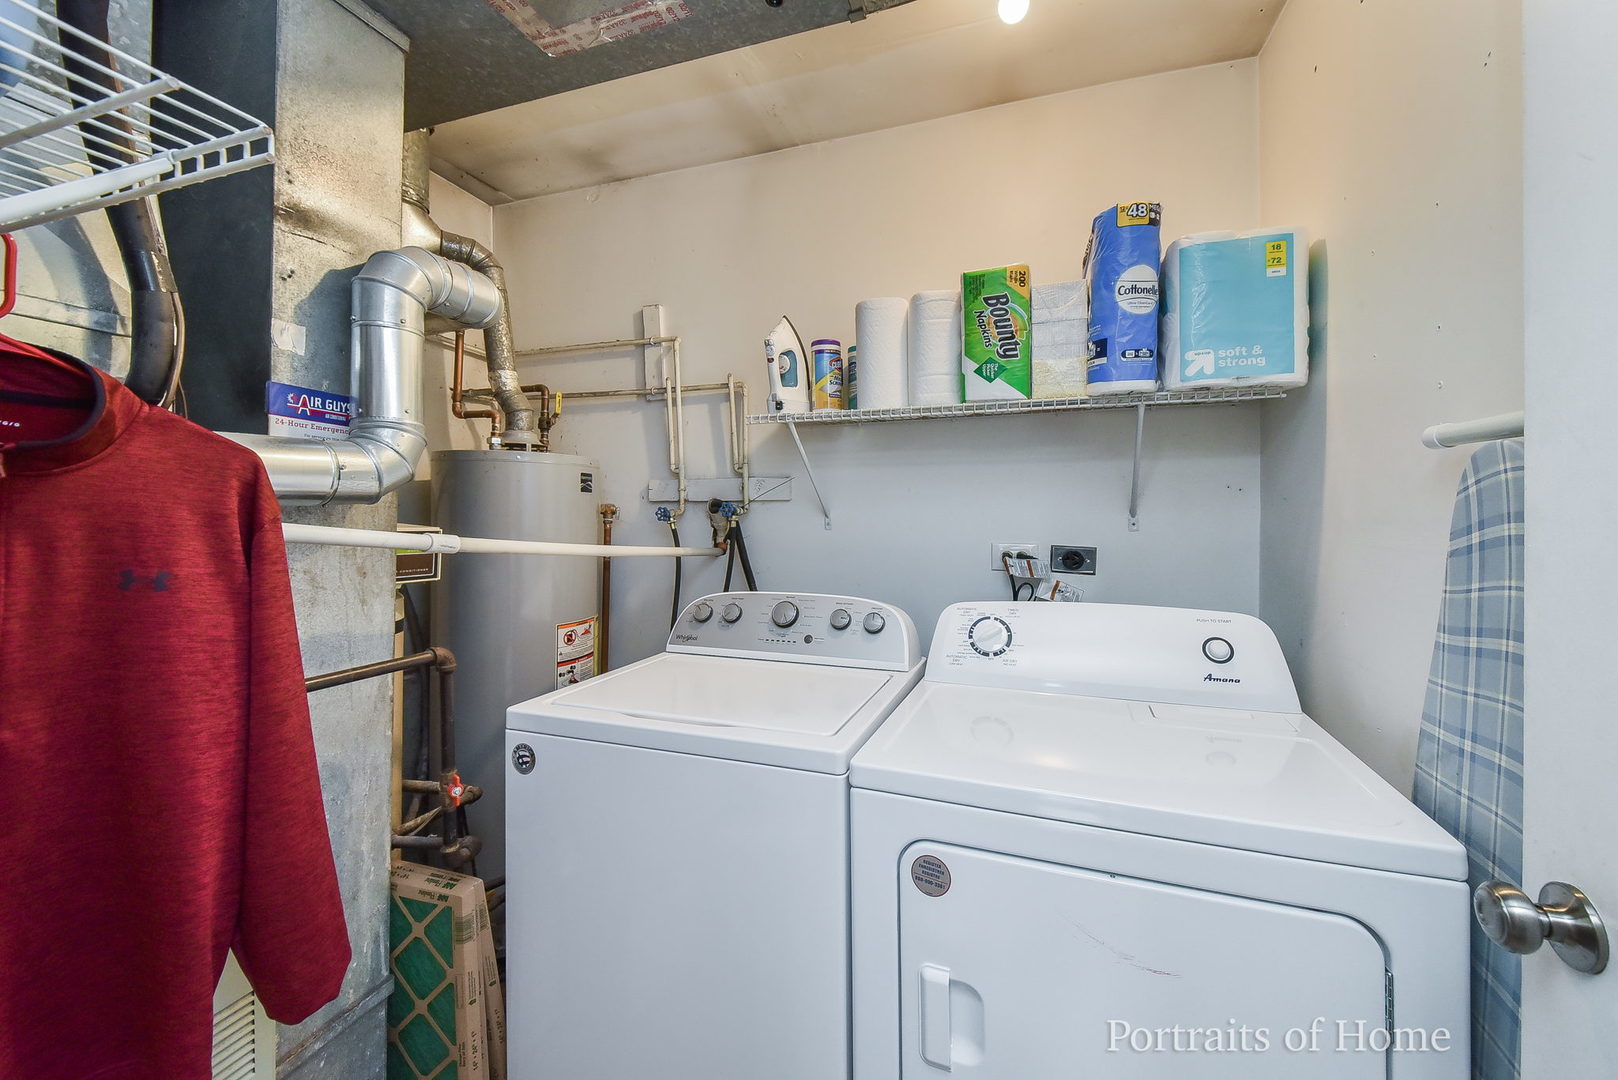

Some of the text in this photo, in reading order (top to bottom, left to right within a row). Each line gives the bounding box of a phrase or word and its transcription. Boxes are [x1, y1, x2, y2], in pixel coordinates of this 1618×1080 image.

[1127, 203, 1148, 217] 48
[1018, 270, 1026, 288] 200
[974, 310, 993, 348] Napkins
[982, 293, 1021, 359] Bounty
[1218, 345, 1263, 357] soft &
[1218, 356, 1266, 367] strong
[275, 417, 350, 435] 24-Hour Emergenc
[1203, 673, 1241, 684] Amana
